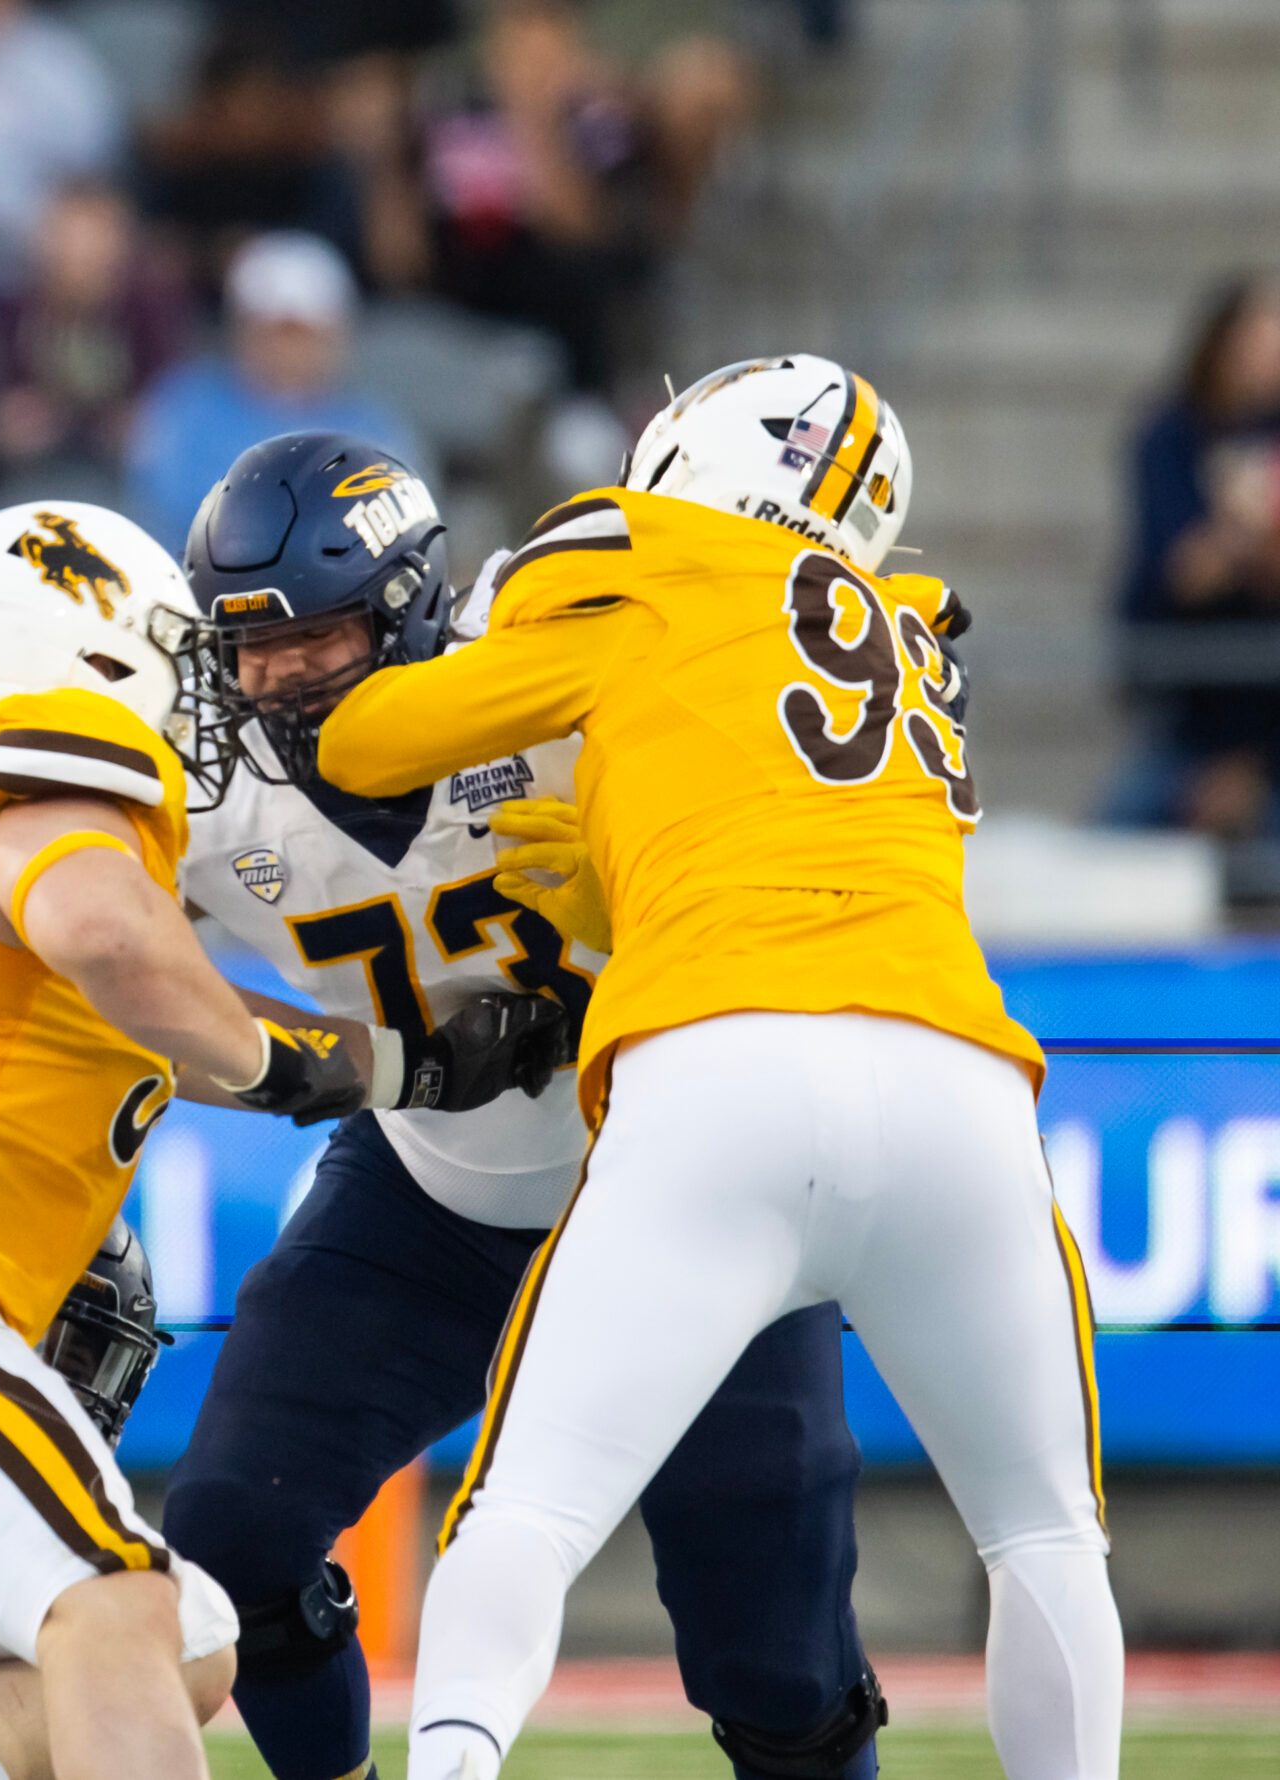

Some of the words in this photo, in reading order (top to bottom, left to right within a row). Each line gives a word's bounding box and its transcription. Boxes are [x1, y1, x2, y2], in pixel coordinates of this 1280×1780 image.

[777, 548, 984, 823] 93
[455, 761, 526, 794] ARIZONA
[470, 779, 519, 804] BOWL
[283, 866, 600, 1072] 73
